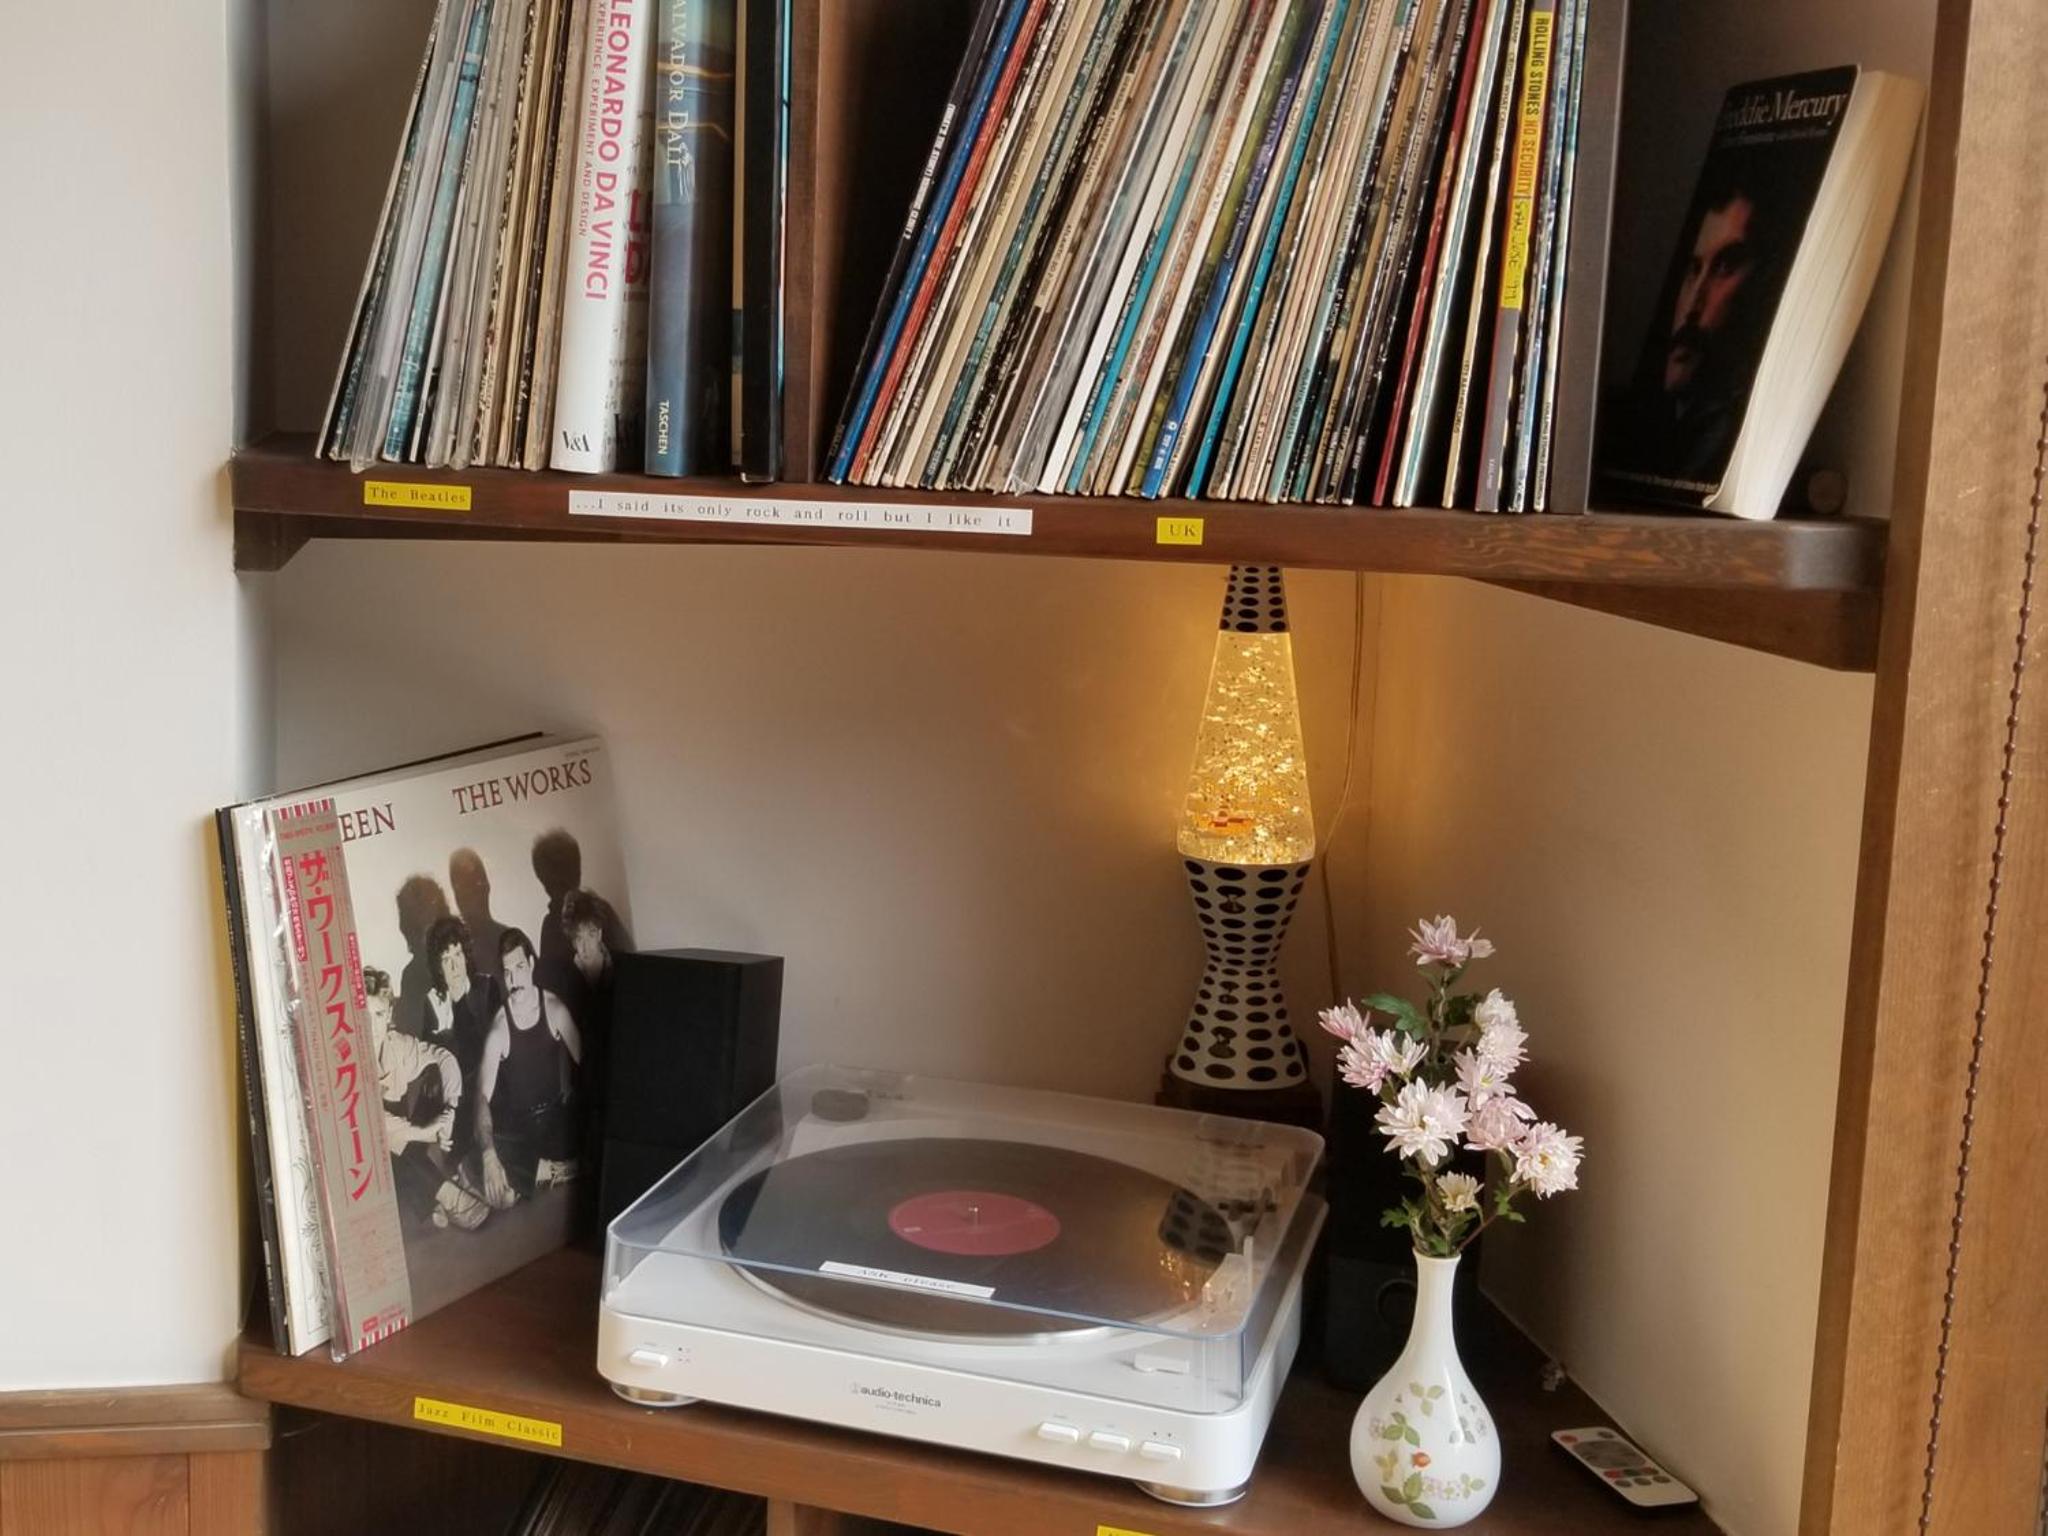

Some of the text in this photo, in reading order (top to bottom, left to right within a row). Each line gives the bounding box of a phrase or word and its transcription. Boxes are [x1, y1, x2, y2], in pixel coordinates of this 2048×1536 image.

[669, 0, 688, 101] ALVADOR
[1514, 18, 1549, 196] ROLLING STONES NO SECURITY
[1770, 90, 1848, 127] Mercury
[585, 0, 632, 300] LEONARDO DA VINCI
[581, 161, 592, 186] AND
[576, 191, 590, 236] DESIGN
[658, 400, 670, 455] TASCHEN
[369, 486, 466, 503] The Beatles
[617, 500, 650, 512] said
[664, 503, 685, 514] its
[697, 505, 732, 517] only
[746, 506, 781, 518] rock
[794, 507, 824, 521] and
[838, 509, 869, 522] roll
[884, 510, 911, 524] but
[949, 513, 982, 526] like
[998, 516, 1012, 528] it
[452, 758, 593, 815] THE WORKS
[339, 803, 396, 843] EEN
[860, 1385, 942, 1408] audio-technica
[417, 1403, 559, 1440] Jazz Film Classic
